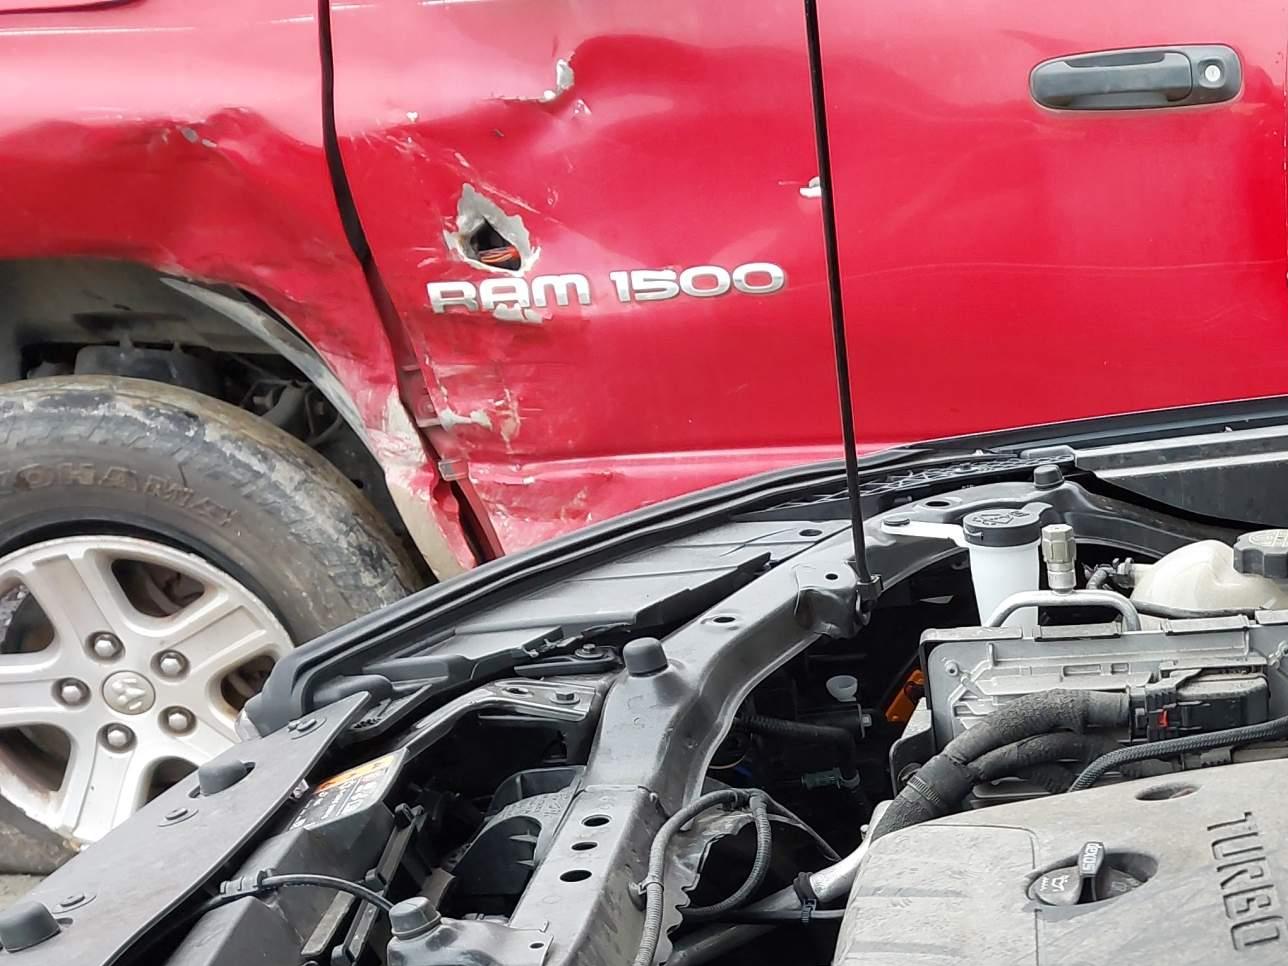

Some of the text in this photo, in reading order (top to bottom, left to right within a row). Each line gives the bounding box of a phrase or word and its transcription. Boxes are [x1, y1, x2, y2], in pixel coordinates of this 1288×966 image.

[426, 262, 785, 314] RAM 1500
[1206, 811, 1284, 951] TURBO
